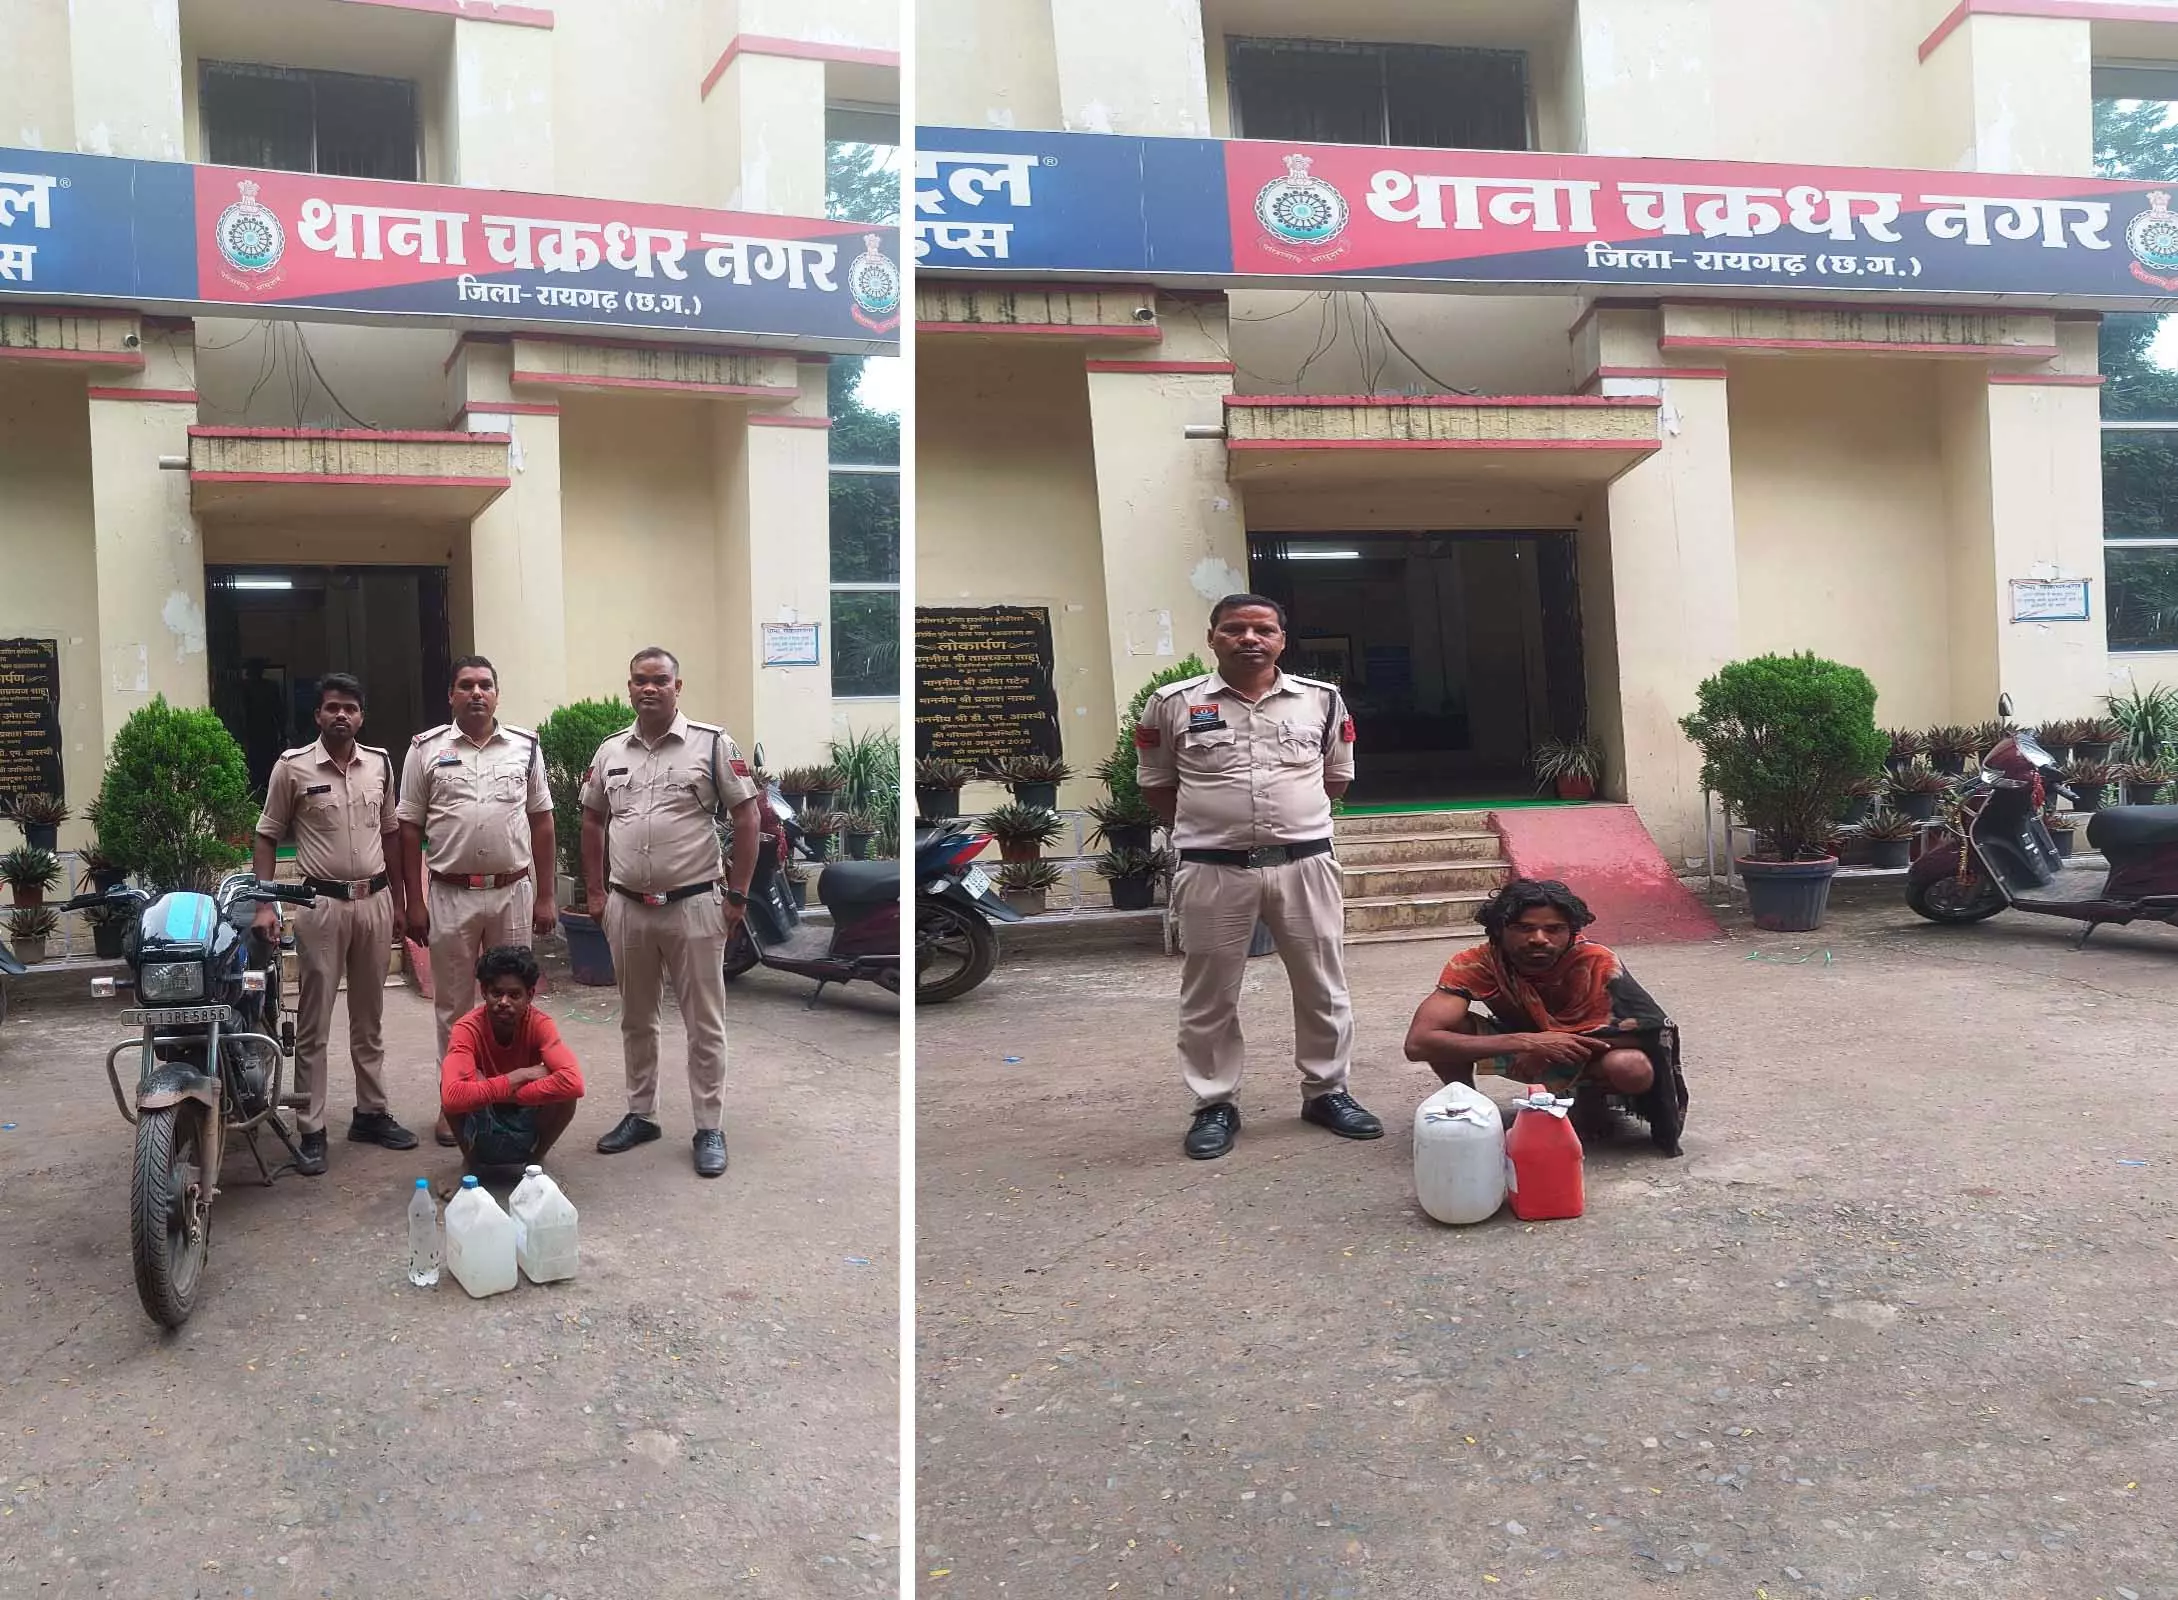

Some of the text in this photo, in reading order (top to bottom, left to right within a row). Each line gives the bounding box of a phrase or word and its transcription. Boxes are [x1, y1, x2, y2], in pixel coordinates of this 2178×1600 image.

[297, 198, 839, 292] थाना चक्रधर नगर
[1365, 168, 2112, 250] थाना चक्रधर नगर
[936, 638, 1007, 650] लोकार्पण
